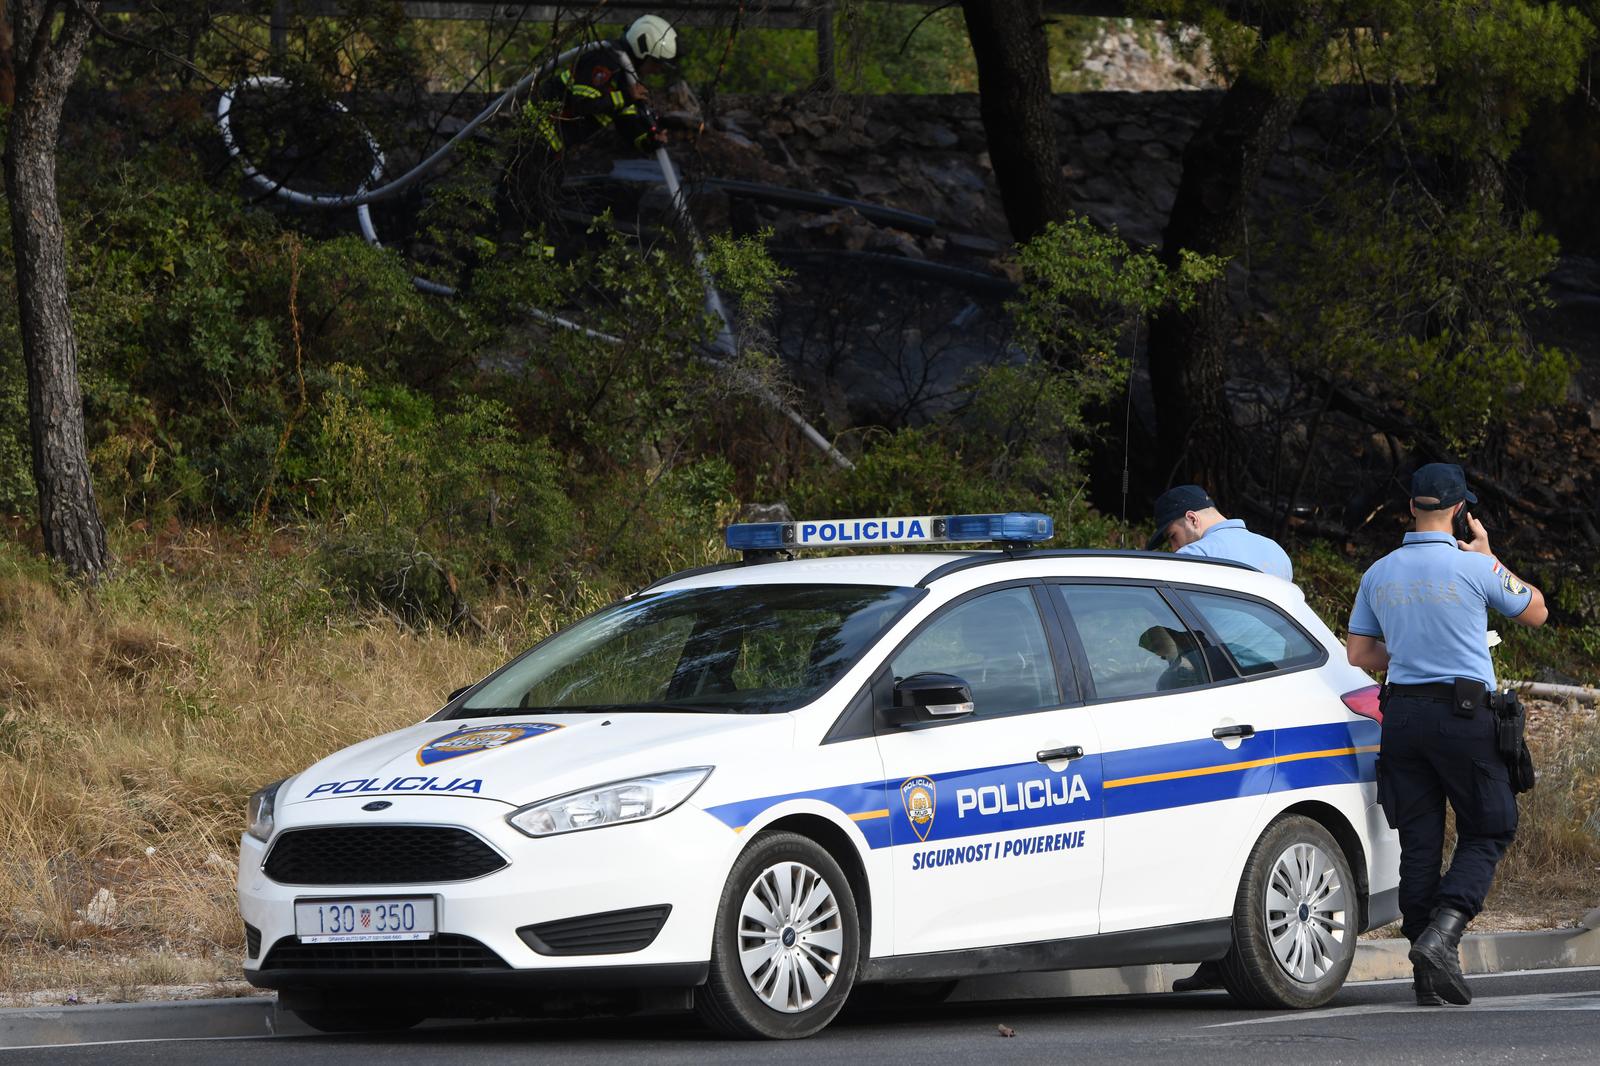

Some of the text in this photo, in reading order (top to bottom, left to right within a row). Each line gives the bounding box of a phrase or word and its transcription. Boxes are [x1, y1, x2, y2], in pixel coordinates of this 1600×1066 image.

[802, 519, 925, 542] POLICIJA
[305, 776, 483, 799] POLICIJA
[903, 779, 933, 793] POLICIJA
[956, 774, 1091, 819] POLICIJA
[912, 830, 1085, 870] SIGURNOST I POVJERENJE
[318, 903, 415, 933] 130 350
